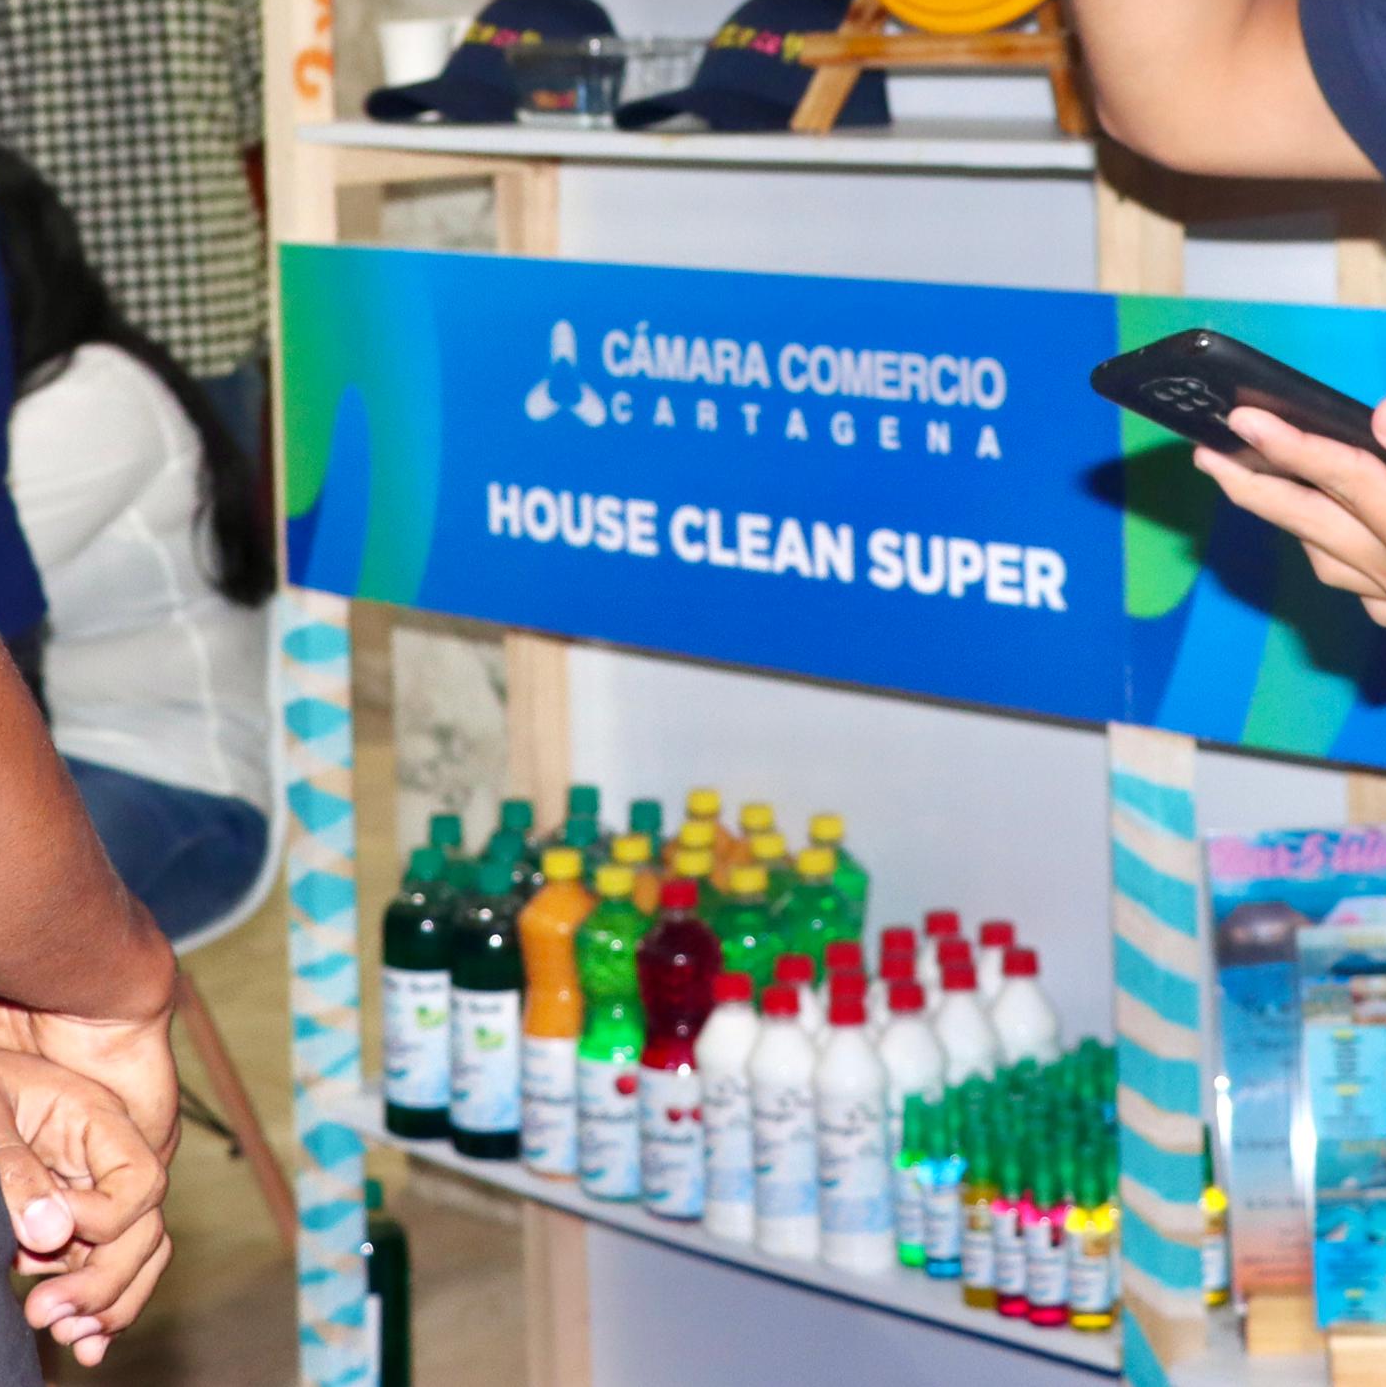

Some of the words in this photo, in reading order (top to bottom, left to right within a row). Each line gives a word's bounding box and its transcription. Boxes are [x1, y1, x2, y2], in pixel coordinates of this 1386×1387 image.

[603, 321, 771, 389] CÁMARA
[778, 341, 1008, 411] COMERCIO
[612, 391, 1002, 460] CARTAGENA
[486, 481, 660, 557] HOUSE
[669, 506, 855, 583] CLEAN
[868, 529, 1068, 612] SUPER
